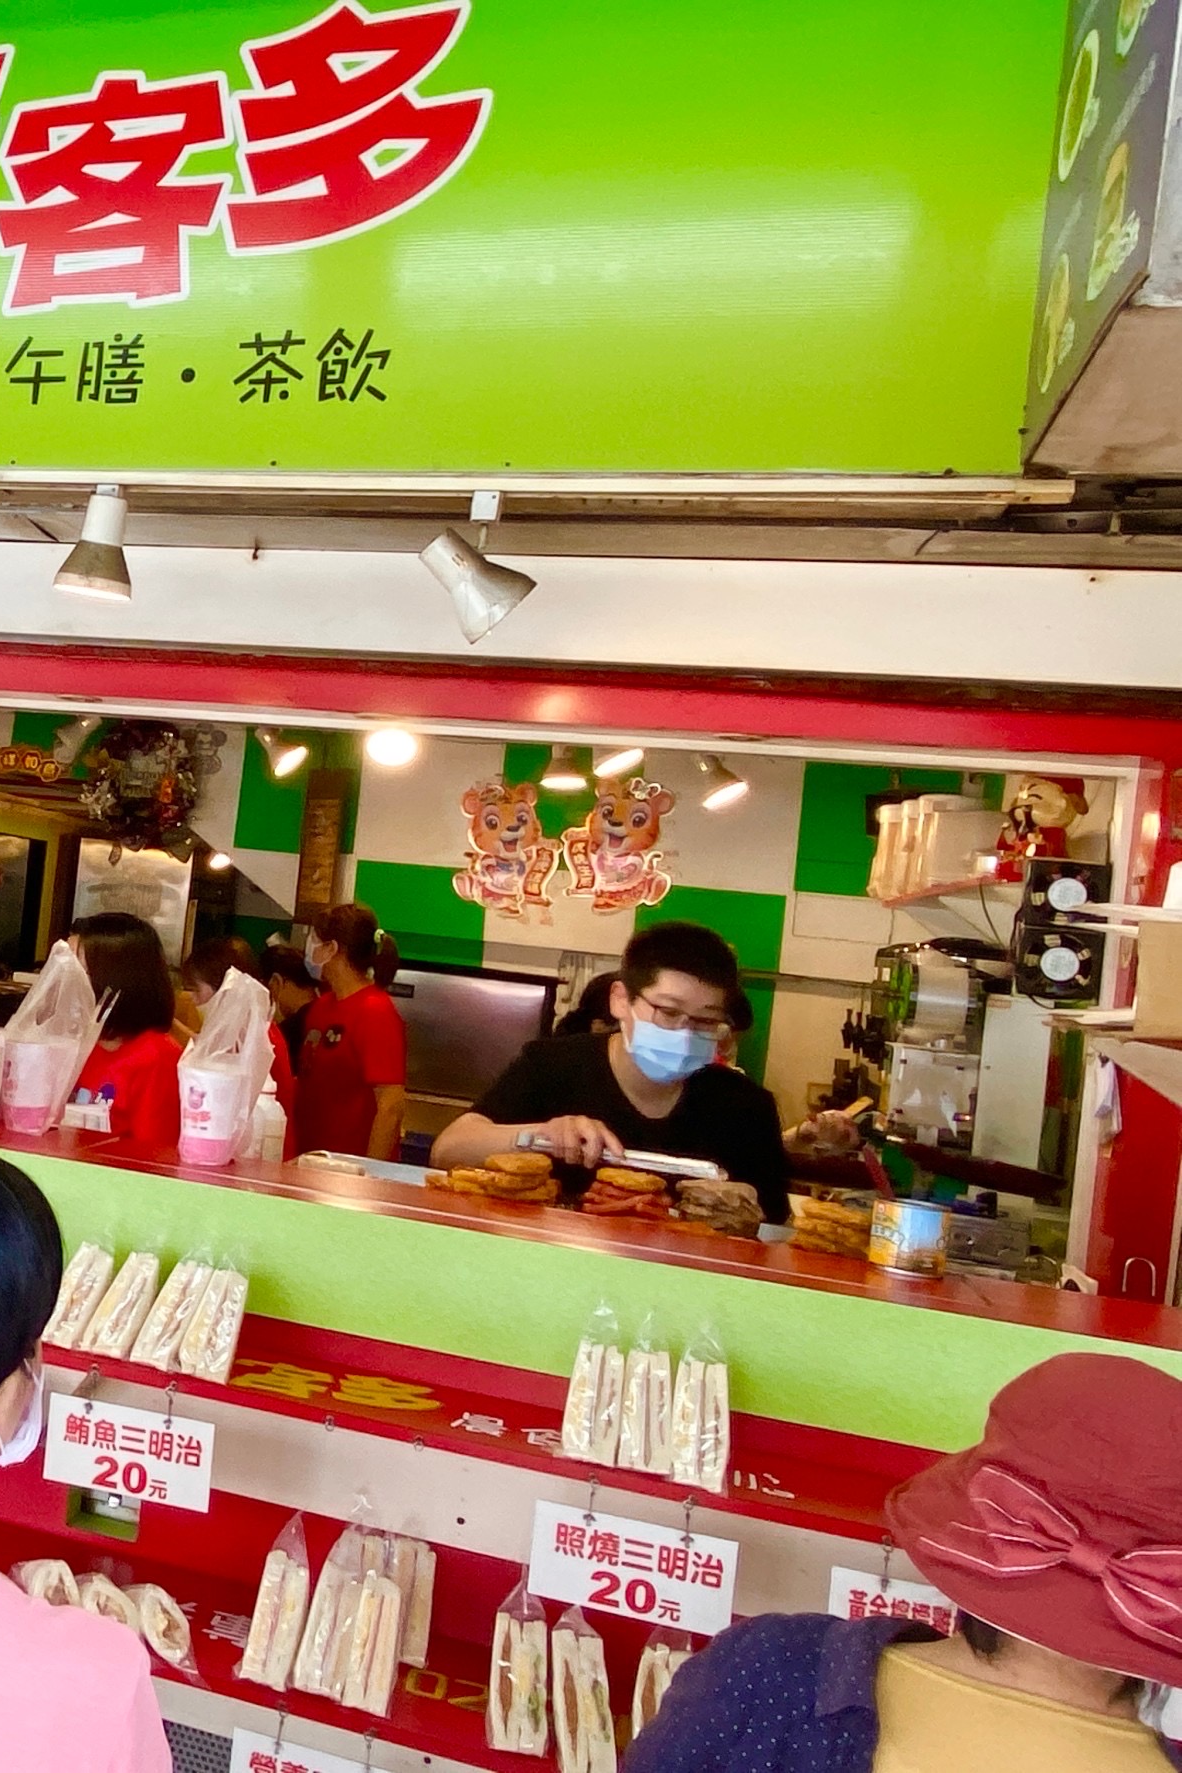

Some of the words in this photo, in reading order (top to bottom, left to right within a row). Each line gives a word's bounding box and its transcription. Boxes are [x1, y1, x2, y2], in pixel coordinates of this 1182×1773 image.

[63, 1412, 203, 1467] 鮪魚三明治
[91, 1456, 168, 1501] 20元
[554, 1522, 725, 1589] 照燒三明治
[587, 1571, 681, 1623] 20元
